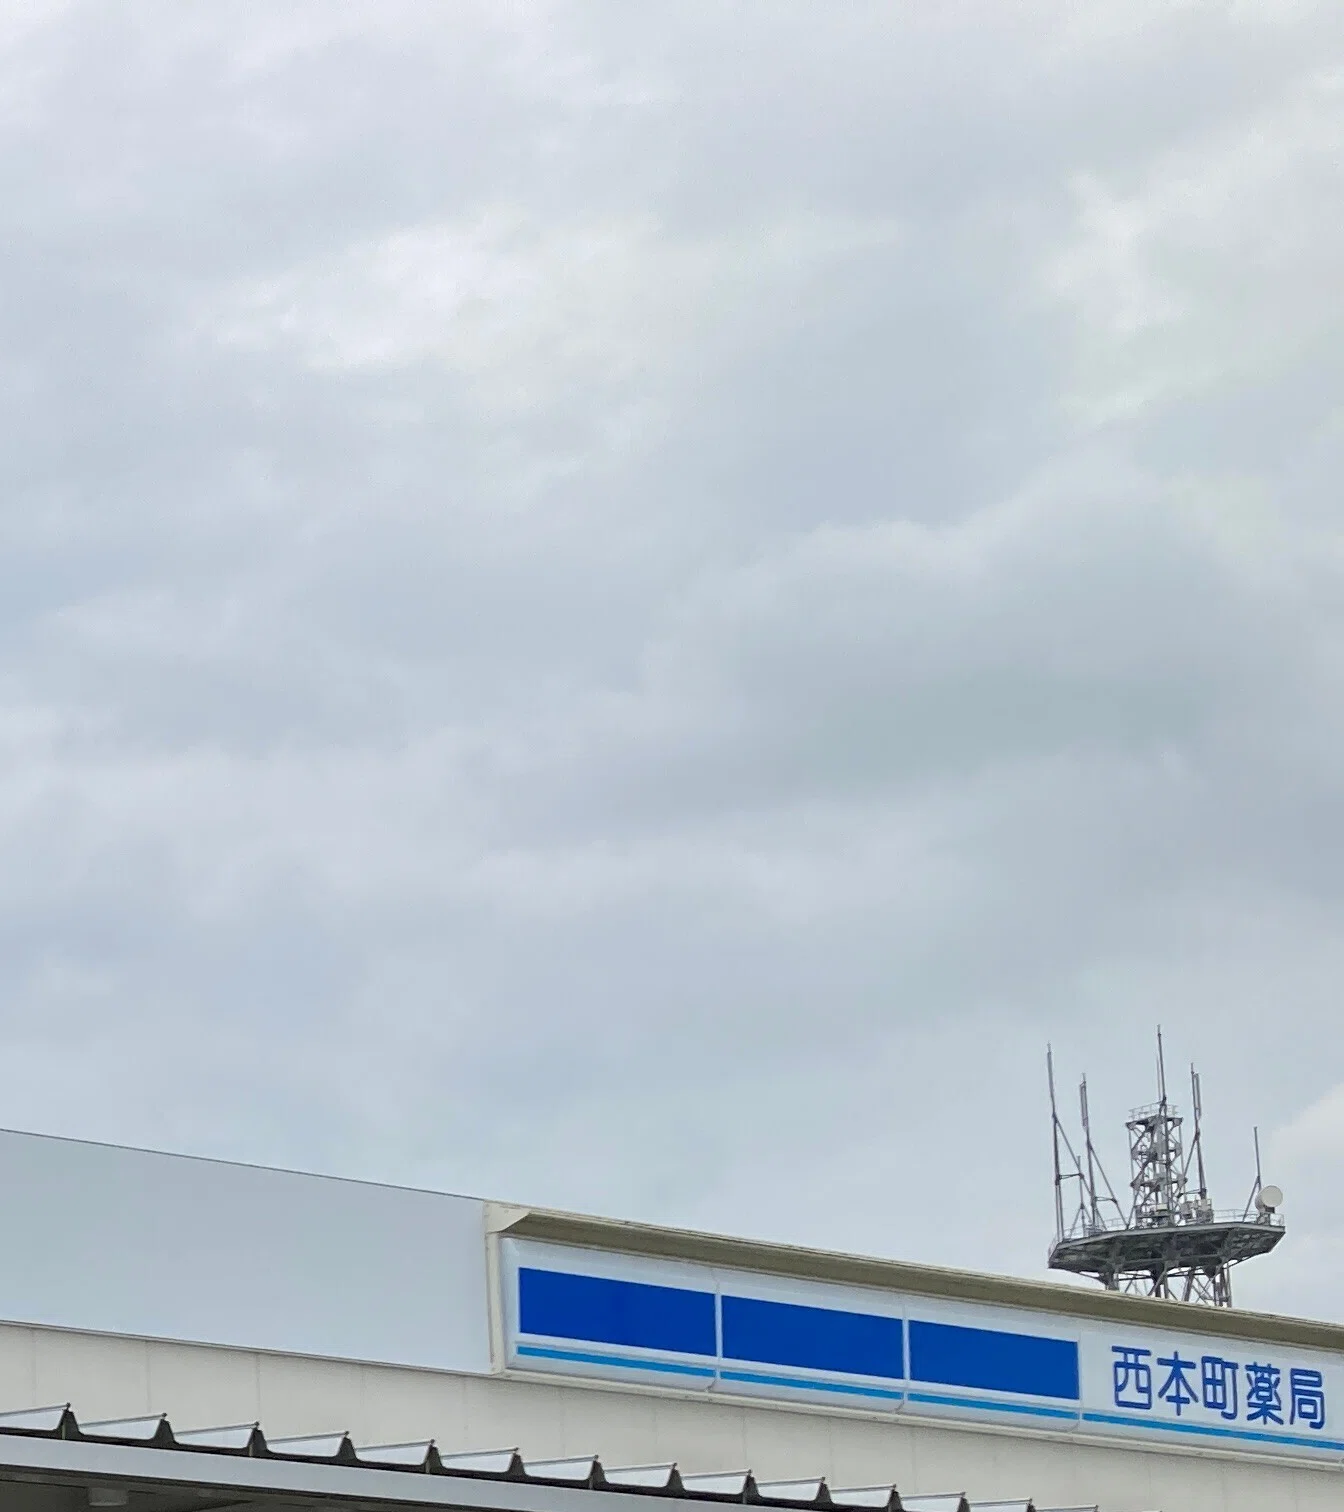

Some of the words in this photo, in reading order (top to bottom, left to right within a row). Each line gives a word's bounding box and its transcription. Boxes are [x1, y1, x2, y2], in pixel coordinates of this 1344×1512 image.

[1111, 1345, 1326, 1430] 西本町薬局
